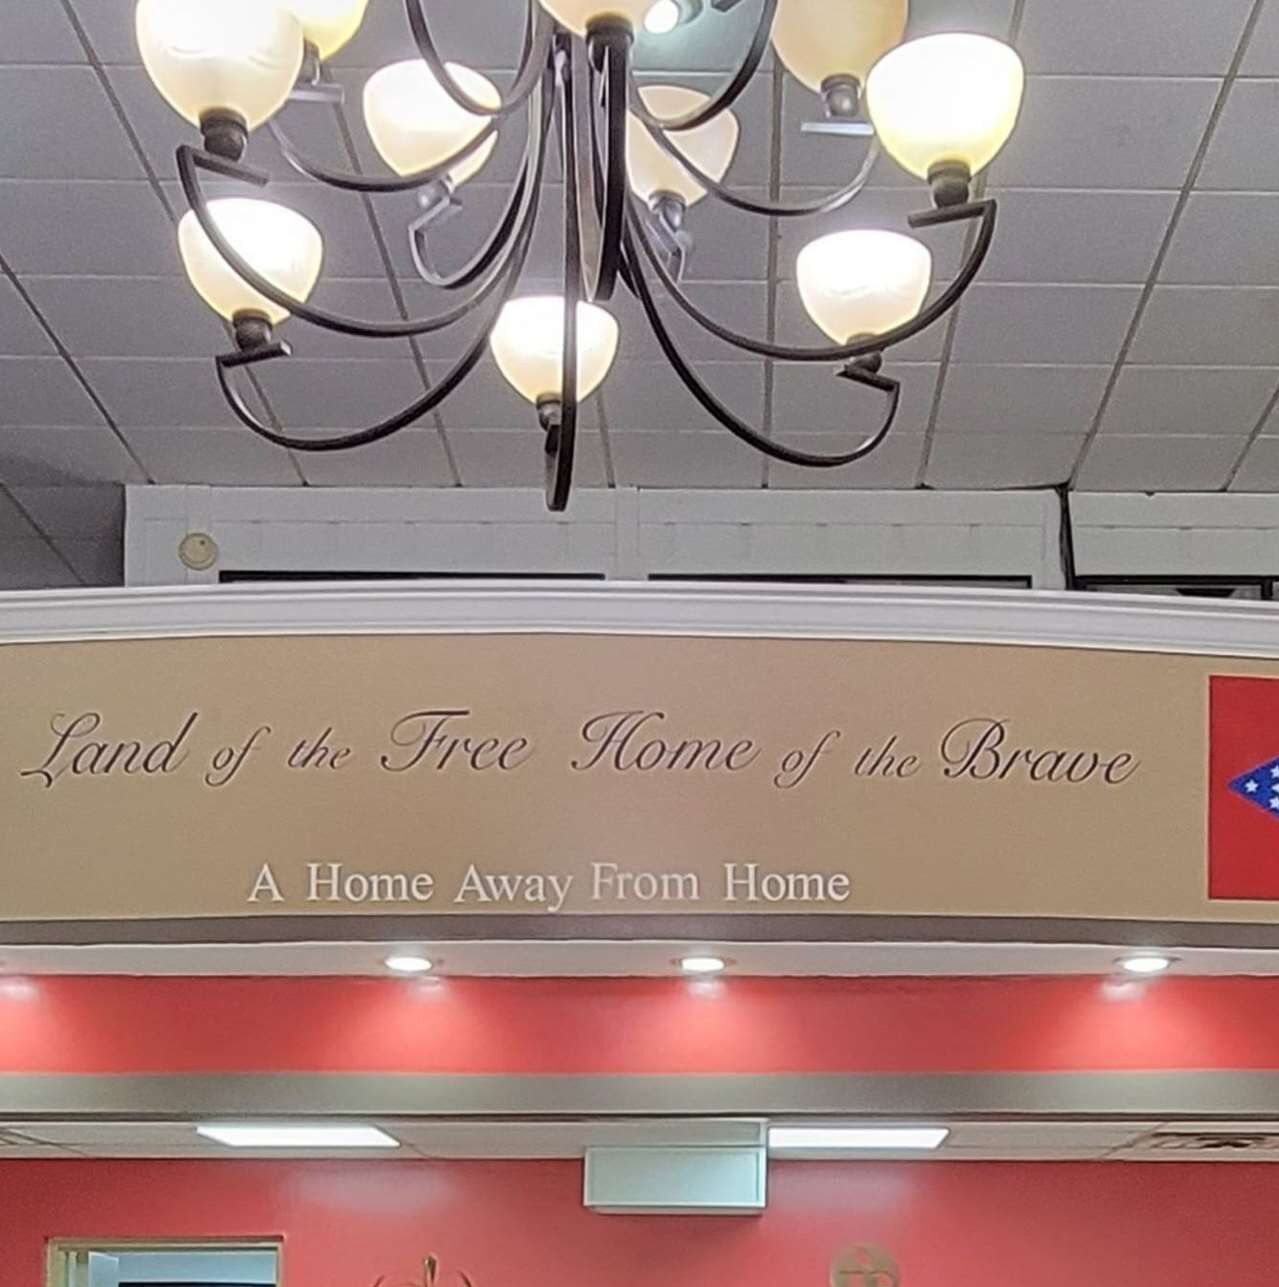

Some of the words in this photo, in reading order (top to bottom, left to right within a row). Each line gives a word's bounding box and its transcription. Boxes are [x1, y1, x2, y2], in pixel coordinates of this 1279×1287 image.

[21, 712, 199, 789] Land
[204, 726, 272, 788] of
[287, 727, 351, 771] the
[380, 709, 532, 772] Free
[571, 711, 761, 772] Home
[773, 730, 841, 790] of
[854, 735, 921, 778] the
[939, 717, 1141, 786] Brave
[248, 863, 283, 903] A
[307, 863, 434, 903] Home
[455, 863, 572, 914] Away
[592, 863, 700, 902] From
[723, 863, 852, 903] Home
